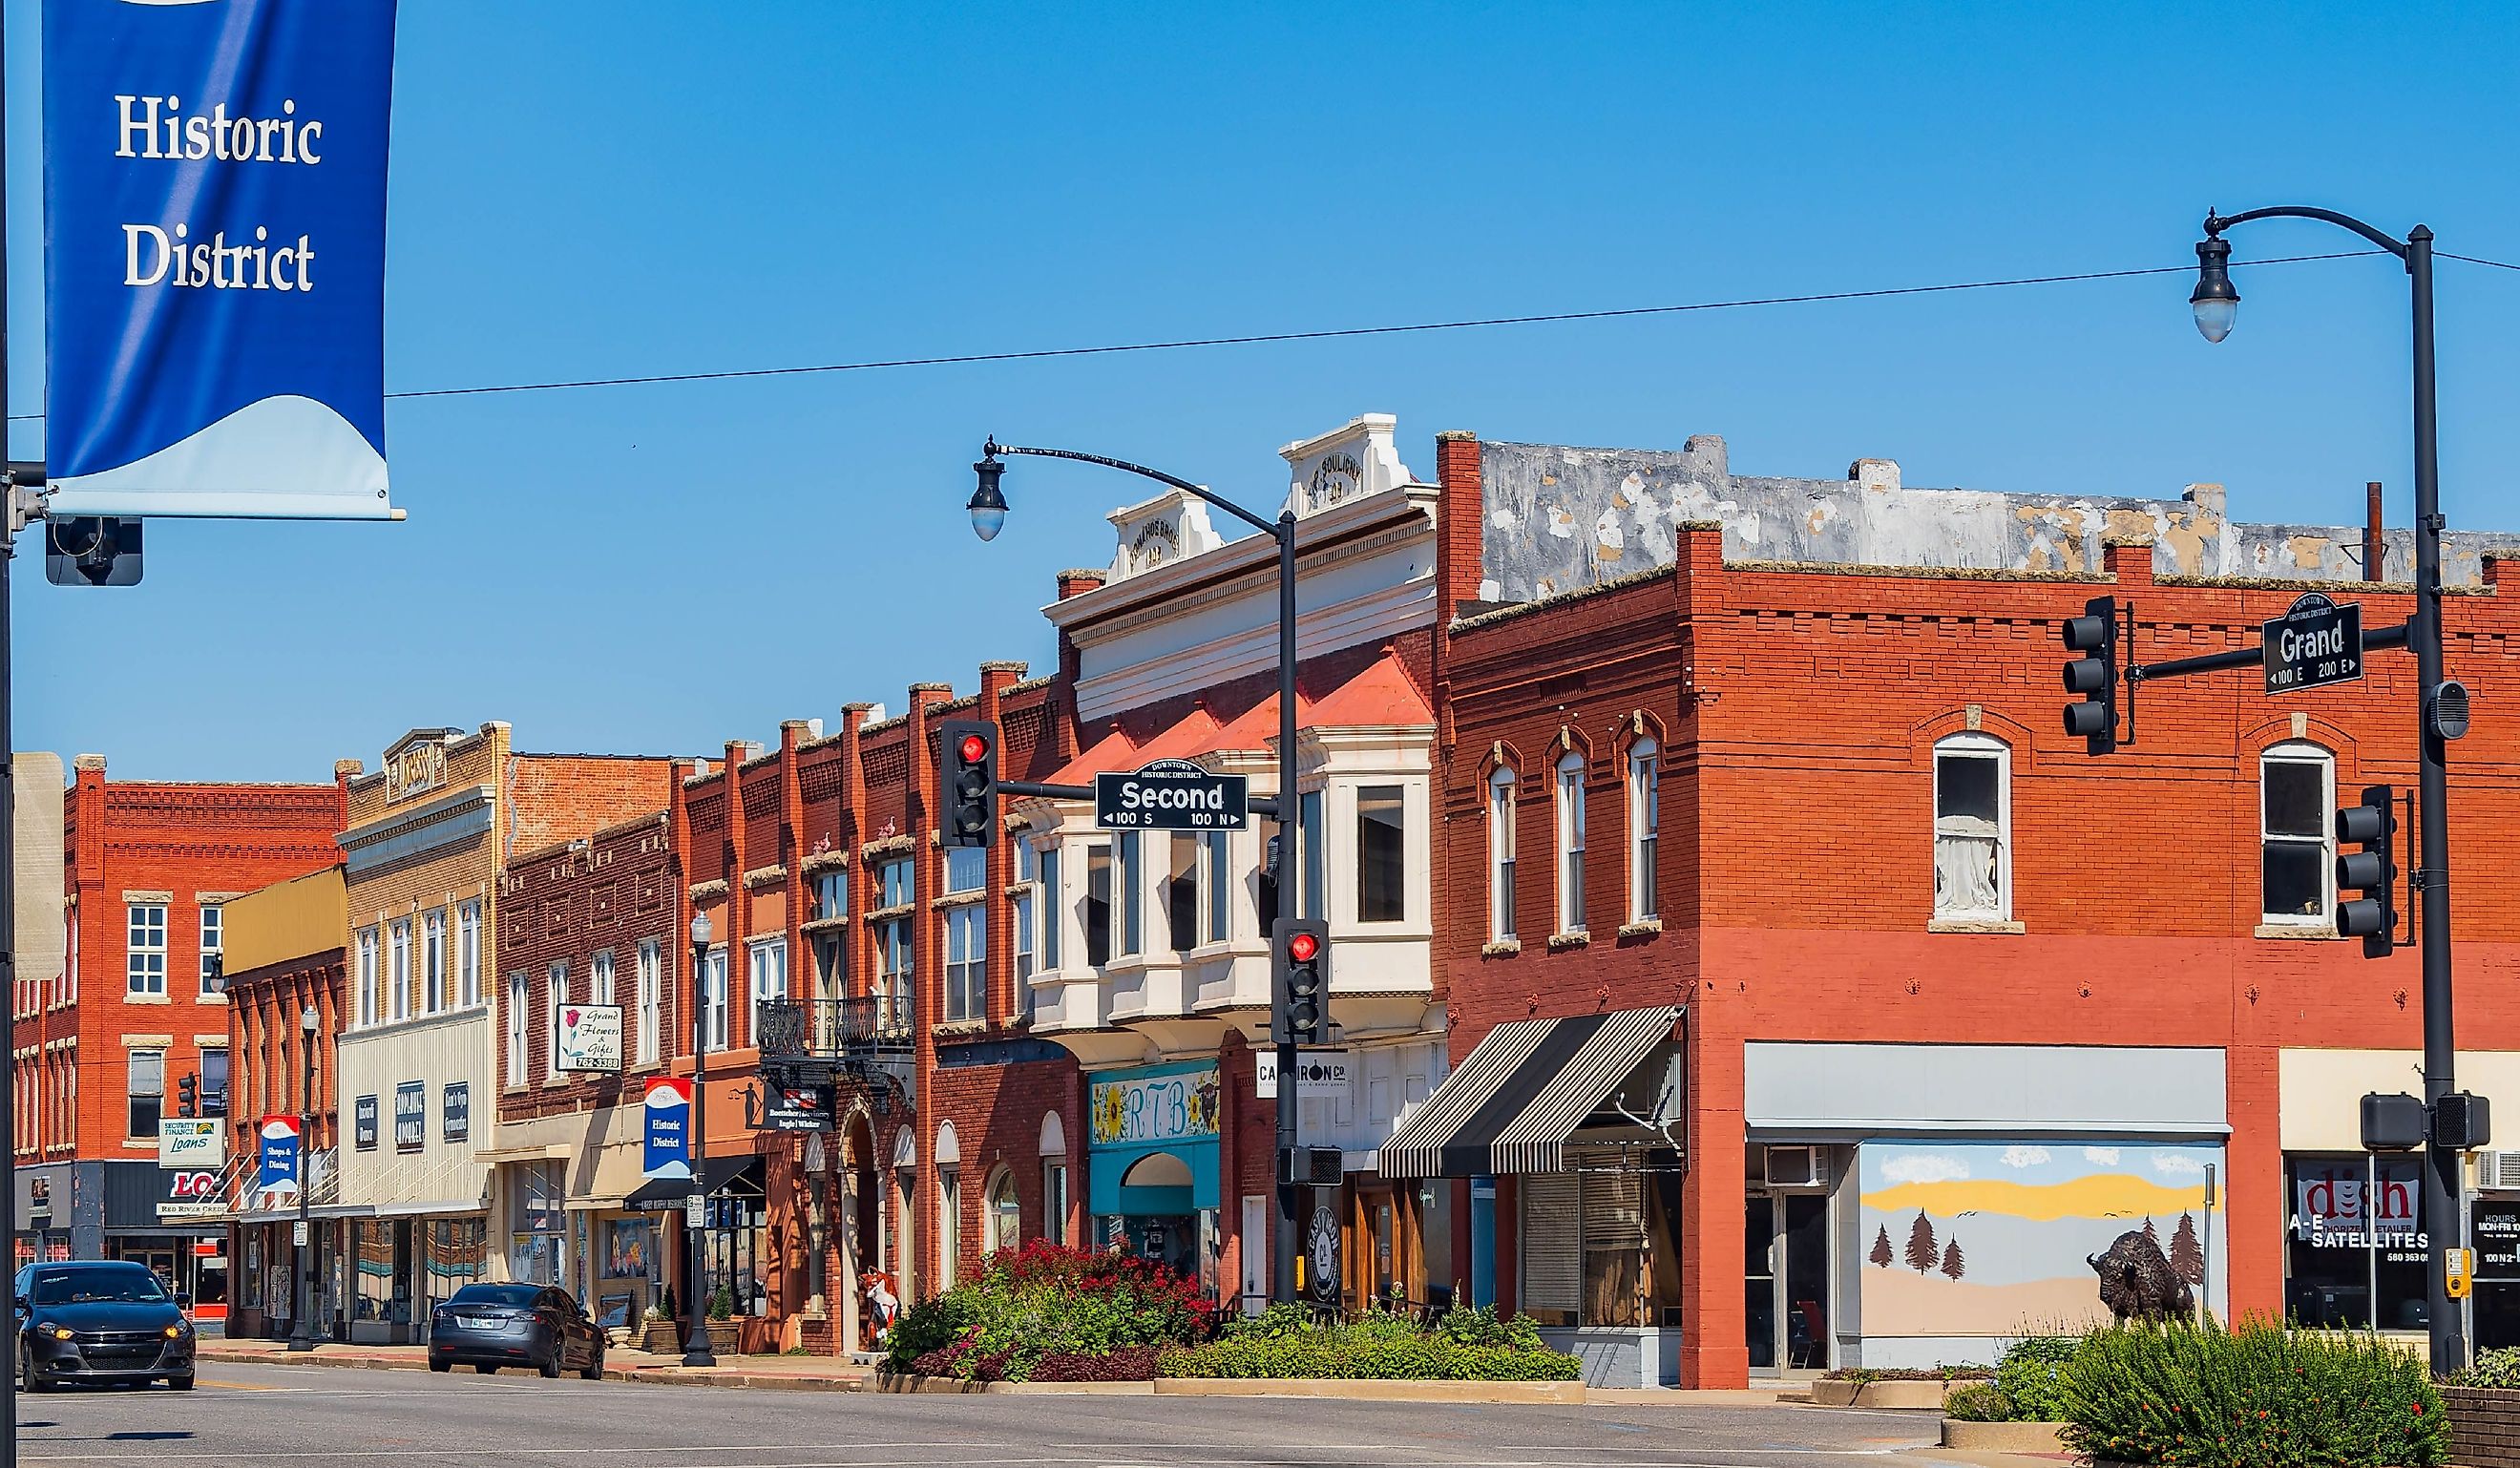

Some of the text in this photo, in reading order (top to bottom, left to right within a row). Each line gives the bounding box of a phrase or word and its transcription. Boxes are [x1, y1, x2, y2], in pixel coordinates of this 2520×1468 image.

[115, 95, 323, 164] Historic
[121, 223, 315, 291] District
[2296, 597, 2324, 610] DOWNTOWN
[2289, 607, 2332, 621] HISTORIC DISTRICT
[2281, 619, 2343, 662] Grand
[2278, 659, 2347, 685] 100 E 200 E
[1151, 762, 1192, 771] DOWNTOWN
[1121, 782, 1224, 809] Second
[1116, 812, 1228, 826] 100 S 100 N
[587, 1010, 619, 1022] Grand
[579, 1023, 620, 1037] Flowers
[587, 1043, 614, 1057] Gifts
[652, 1119, 681, 1130] Historic
[170, 1137, 208, 1153] Loans
[652, 1137, 680, 1147] District
[267, 1147, 292, 1158] Shops &
[268, 1161, 290, 1171] Dining
[2288, 1213, 2323, 1230] A-E
[2485, 1214, 2517, 1223] HOURS
[2312, 1232, 2428, 1248] SATELLITES
